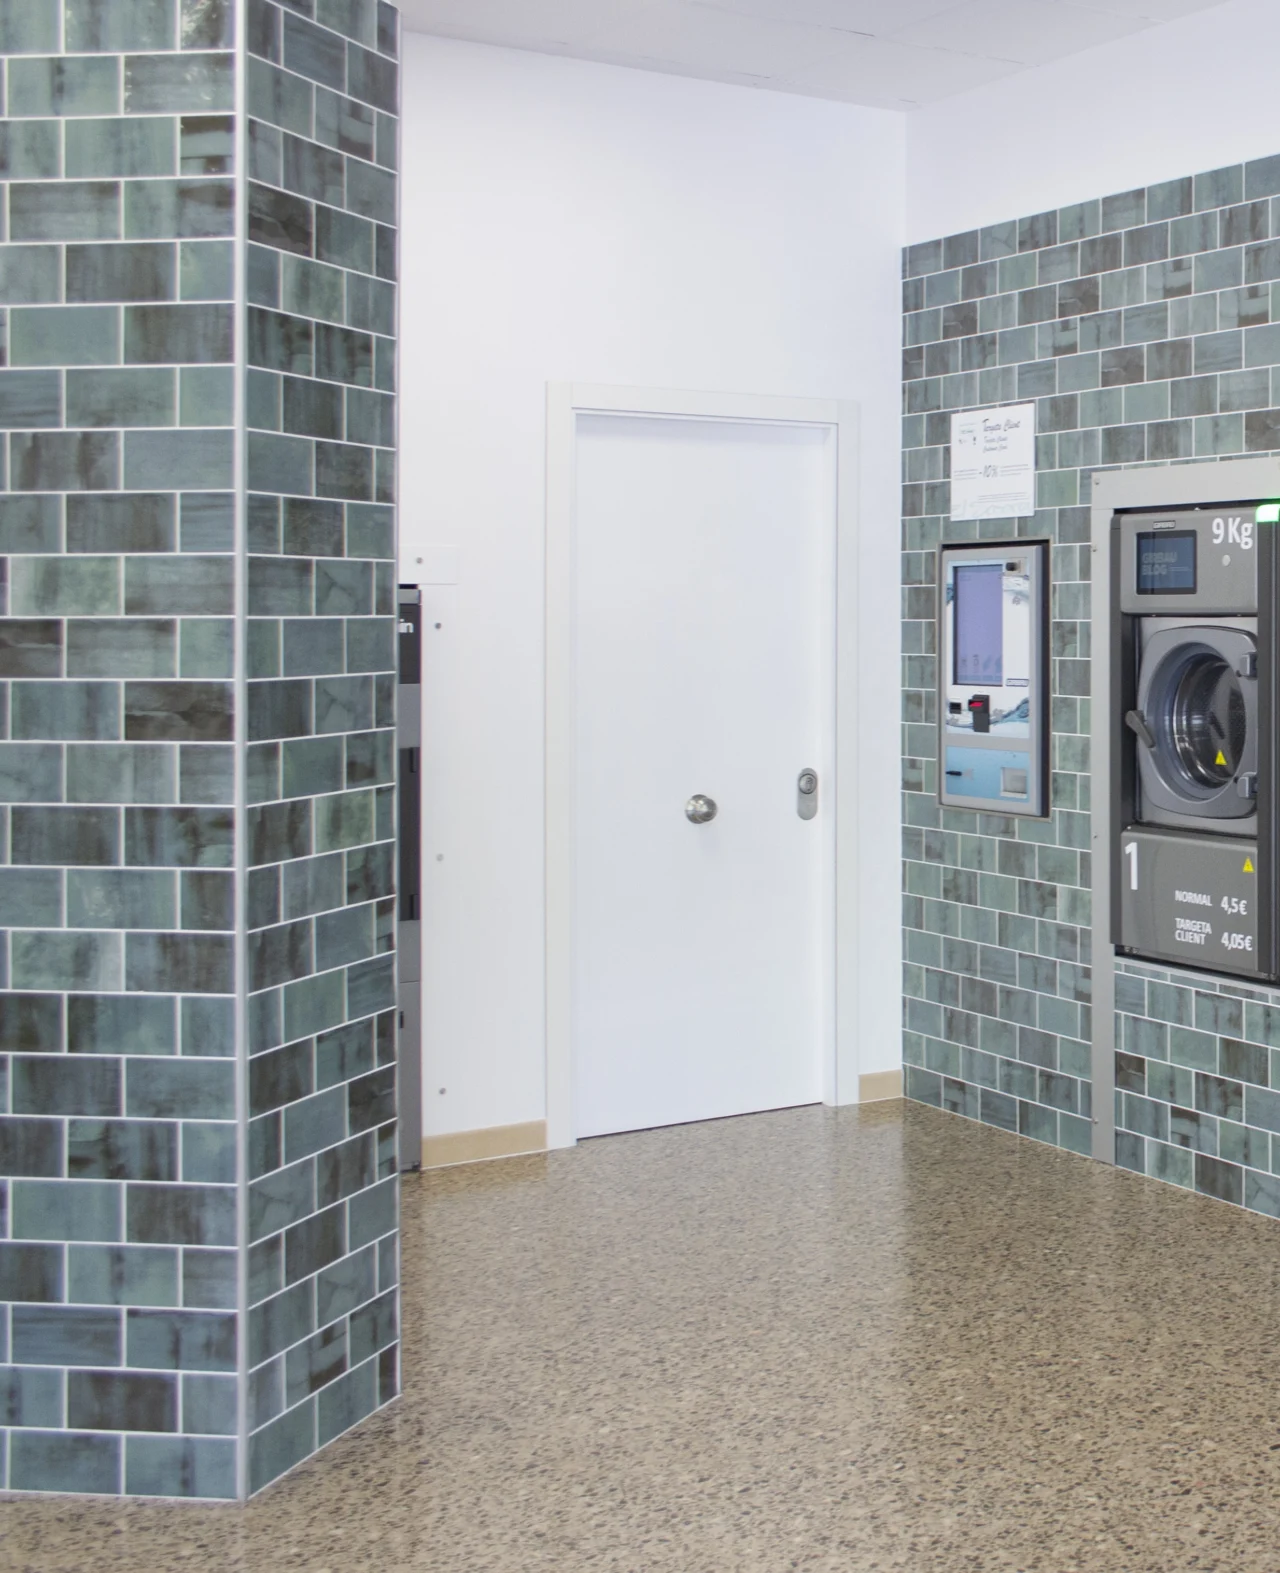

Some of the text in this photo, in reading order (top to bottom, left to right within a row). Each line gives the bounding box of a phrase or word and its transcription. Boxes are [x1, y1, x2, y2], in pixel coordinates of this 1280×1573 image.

[1124, 842, 1138, 890] 1
[1175, 890, 1247, 915] NORMAL 4,5€
[1175, 917, 1212, 934] TARGETA
[1175, 929, 1253, 951] CLIENT 4,05€
